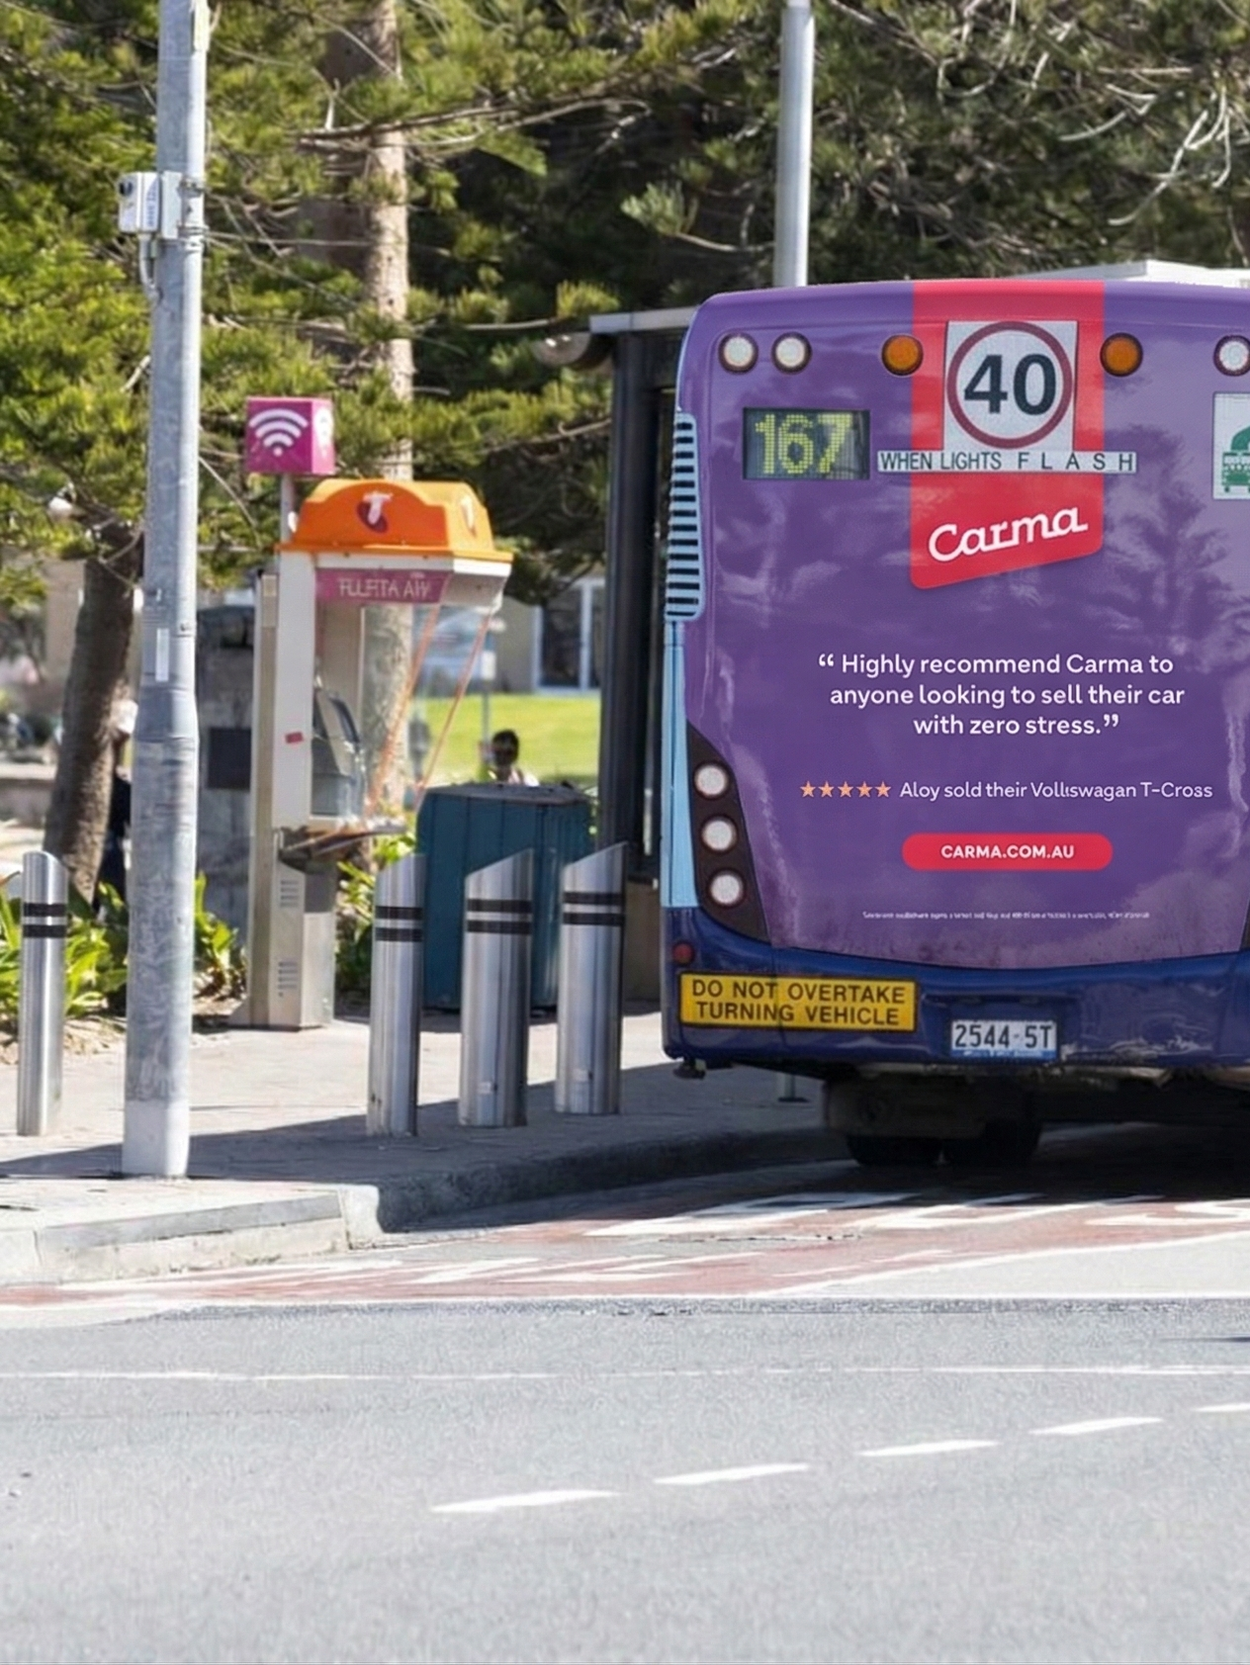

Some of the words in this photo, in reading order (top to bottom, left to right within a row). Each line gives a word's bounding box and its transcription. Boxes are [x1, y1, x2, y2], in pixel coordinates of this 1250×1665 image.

[964, 353, 1057, 416] 40
[755, 413, 852, 474] 167
[880, 452, 933, 471] WHEN
[940, 452, 1003, 471] LIGHTS
[928, 506, 1089, 562] Carma
[920, 654, 1060, 674] recommend
[1066, 654, 1143, 674] Carma
[1149, 656, 1174, 674] to
[830, 688, 914, 709] anyone
[919, 684, 1005, 708] looking
[1011, 686, 1035, 704] to
[1041, 684, 1082, 704] sell
[1088, 684, 1143, 704] their
[1148, 689, 1184, 704] car
[913, 714, 964, 734] with
[970, 719, 1020, 734] zero
[900, 781, 940, 801] Aloy
[944, 781, 980, 798] sold
[985, 781, 1027, 798] their
[1141, 782, 1213, 798] T-Cross
[941, 844, 1075, 859] CARMA.COM.AU
[692, 978, 722, 998] DO
[733, 980, 777, 1000] NOT
[787, 982, 905, 1004] OVERTAKE
[697, 1001, 793, 1023] TURNING
[804, 1005, 898, 1026] VEHICLE
